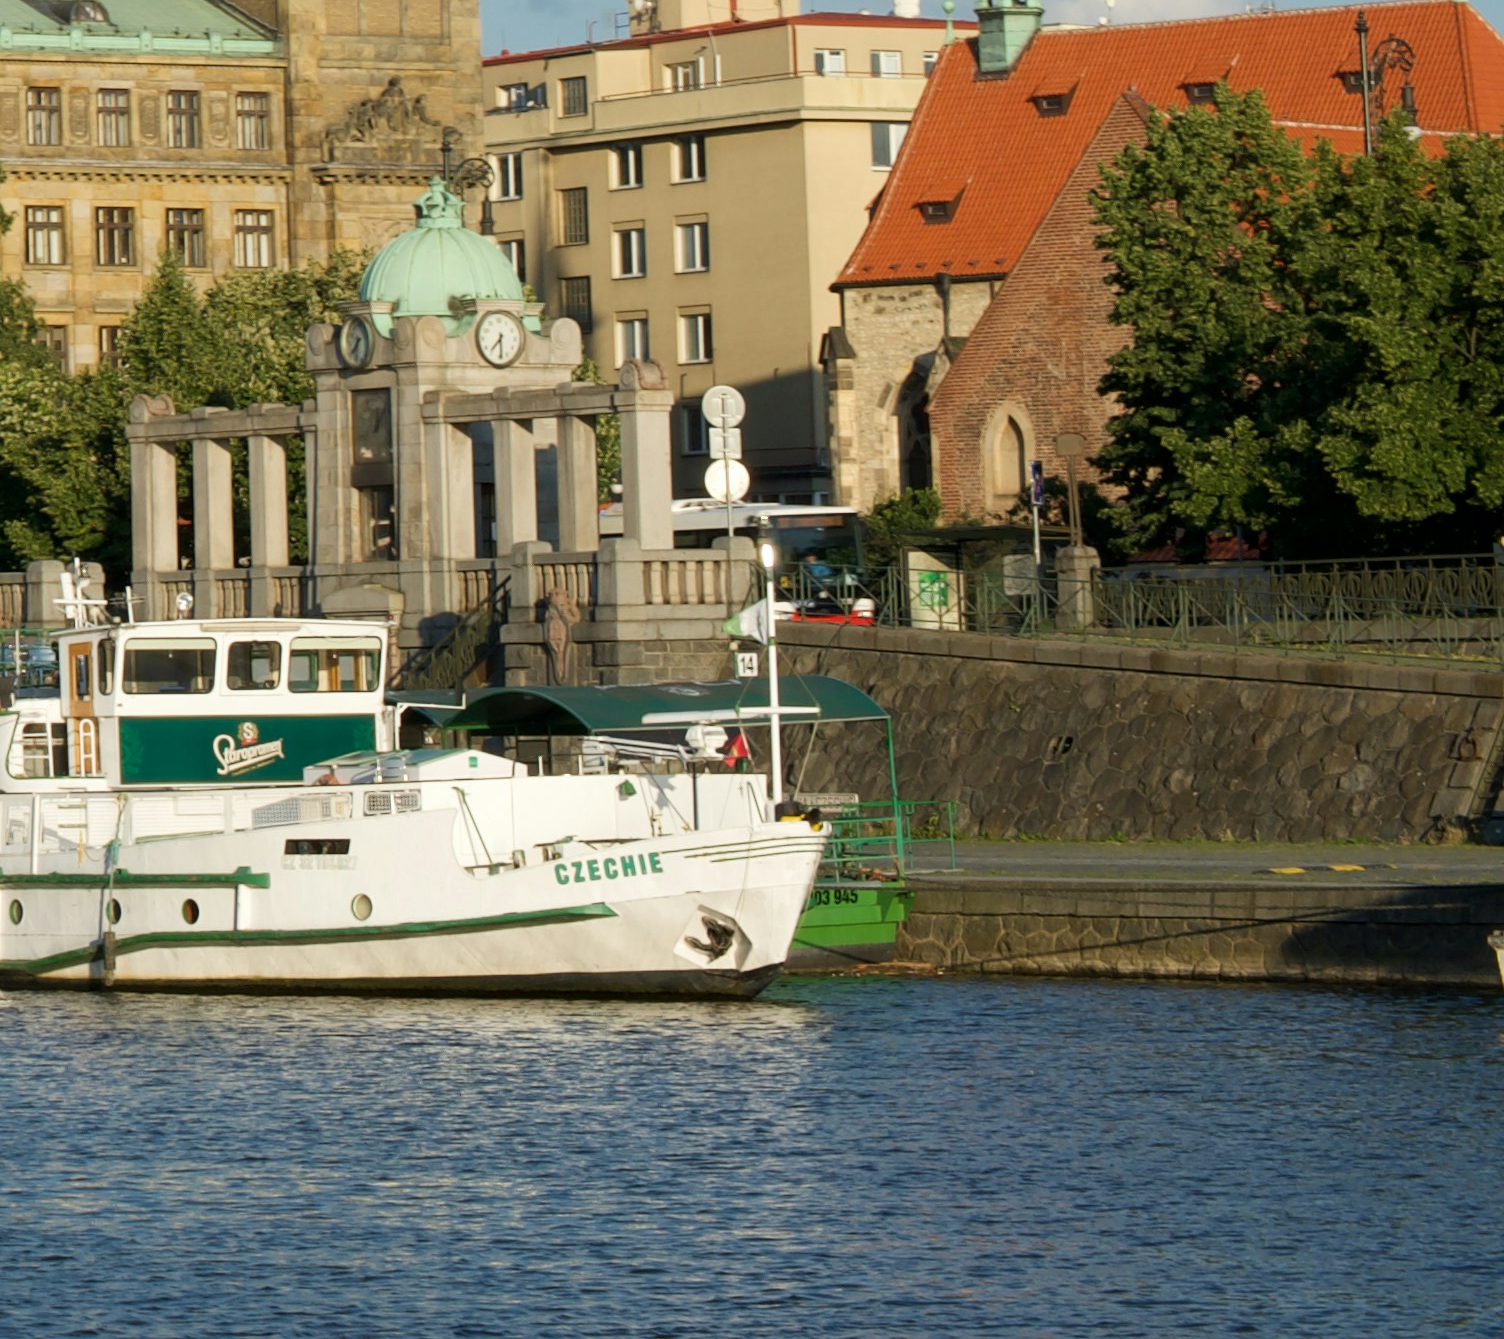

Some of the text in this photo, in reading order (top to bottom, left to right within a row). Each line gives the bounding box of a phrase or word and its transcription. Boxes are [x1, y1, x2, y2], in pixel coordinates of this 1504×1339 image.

[740, 656, 753, 673] 14
[554, 852, 663, 885] CZECHIE
[834, 889, 858, 904] 945
